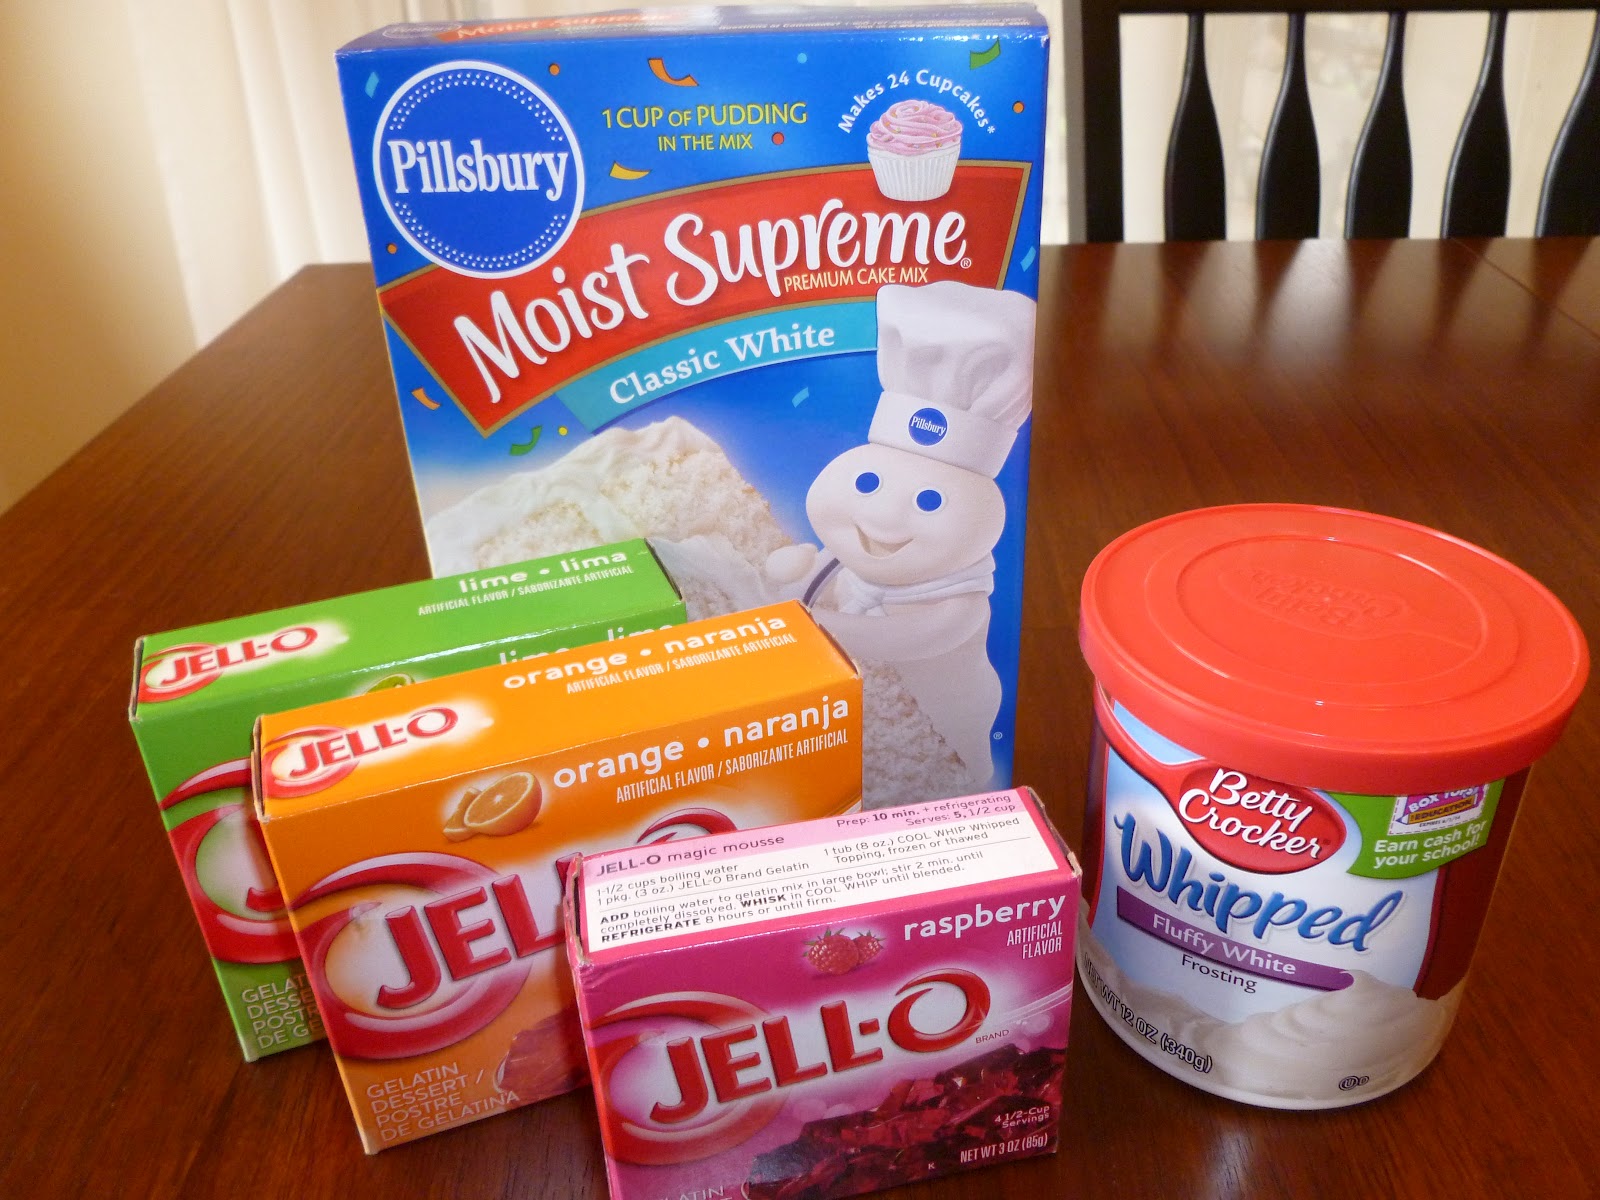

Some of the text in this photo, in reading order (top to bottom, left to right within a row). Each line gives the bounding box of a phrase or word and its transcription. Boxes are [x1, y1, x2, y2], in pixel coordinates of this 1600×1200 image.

[668, 110, 692, 127] OF
[697, 102, 808, 127] PUDDING
[838, 83, 884, 134] Makes
[887, 70, 910, 90] 24
[658, 133, 753, 151] IN THE MIX
[387, 138, 569, 202] Pillsbury
[454, 197, 968, 404] Moist Supreme
[784, 267, 929, 293] PREMIUM CAKE MIX
[610, 323, 835, 404] Classic White
[911, 416, 947, 437] Pillsbury
[418, 565, 634, 616] ARTIFICIAL FLAVOR SABORIZANTE ARTIFICIAL
[459, 551, 627, 593] lime lima
[160, 627, 318, 686] JELL-O
[504, 616, 787, 689] orange naranja
[566, 633, 798, 694] ARTIFICIAL FLAVOR SABORIZANTE ARTIFICIAL
[290, 706, 459, 777] JELL-O
[553, 695, 849, 788] orange naranja
[616, 774, 673, 804] ARTIFICIAL
[675, 762, 715, 788] FLAVOR
[725, 743, 794, 776] SABORIZANTE
[796, 729, 849, 757] ARTIFICIAL
[836, 794, 1012, 828] Prep: 10 min. refrigerating
[905, 804, 1016, 827] Serves: 5, 1/2 cup
[1208, 767, 1313, 833] Betty
[1409, 794, 1440, 813] BOX
[832, 846, 852, 856] tub
[855, 842, 869, 852] (8
[872, 838, 894, 849] oz.)
[897, 833, 932, 844] COOL
[934, 826, 966, 838] WHIP
[969, 817, 1020, 832] Whipped
[1178, 788, 1323, 860] Crocker
[1374, 839, 1419, 853] Earn
[1423, 829, 1462, 849] cash
[1465, 820, 1488, 837] for
[596, 836, 785, 877] JELL-O magic mousse
[833, 831, 989, 864] Topping, frozen or thawed
[1373, 833, 1481, 870] your school!
[596, 864, 739, 897] 1-1/2 cups boiling water
[600, 911, 629, 925] ADD
[634, 903, 675, 918] boiling
[680, 897, 714, 910] water
[719, 894, 731, 903] to
[735, 886, 778, 902] gelatin
[782, 882, 803, 893] mix
[807, 880, 819, 888] in
[822, 875, 853, 887] large
[856, 868, 889, 880] bowl;
[892, 863, 912, 874] stir
[927, 858, 954, 868] min.
[956, 851, 984, 863] until
[600, 864, 965, 934] completely dissolved. WHISK in COOL WHIP until blended.
[606, 894, 631, 907] pkg.
[635, 889, 648, 899] (3
[652, 884, 674, 896] oz.)
[678, 876, 722, 891] JELL-O
[726, 868, 762, 882] Brand
[766, 862, 810, 875] Gelatin
[1113, 812, 1404, 952] Whipped
[601, 895, 837, 943] REFRIGERATE 8 hours or until firm.
[904, 895, 1066, 941] raspberry
[1007, 920, 1063, 947] ARTIFICIAL
[1022, 937, 1062, 960] FLAVOR
[1152, 913, 1297, 975] Fluffy White
[1182, 953, 1258, 994] Frosting
[257, 1029, 289, 1049] DE
[650, 967, 991, 1126] JELL-O
[975, 1029, 1010, 1044] BRAND
[1121, 1003, 1135, 1027] 12
[1136, 1016, 1159, 1044] OZ
[1160, 1032, 1213, 1074] (340g)
[366, 1061, 460, 1099] GELATIN
[371, 1074, 469, 1114] DESSERT
[376, 1092, 462, 1129] POSTRE
[380, 1091, 520, 1142] DE GELATINA
[995, 1105, 1050, 1123] 4 1/2-Cup
[1002, 1112, 1050, 1128] Servings
[960, 1132, 1048, 1164] NET WT 3 OZ (85g)
